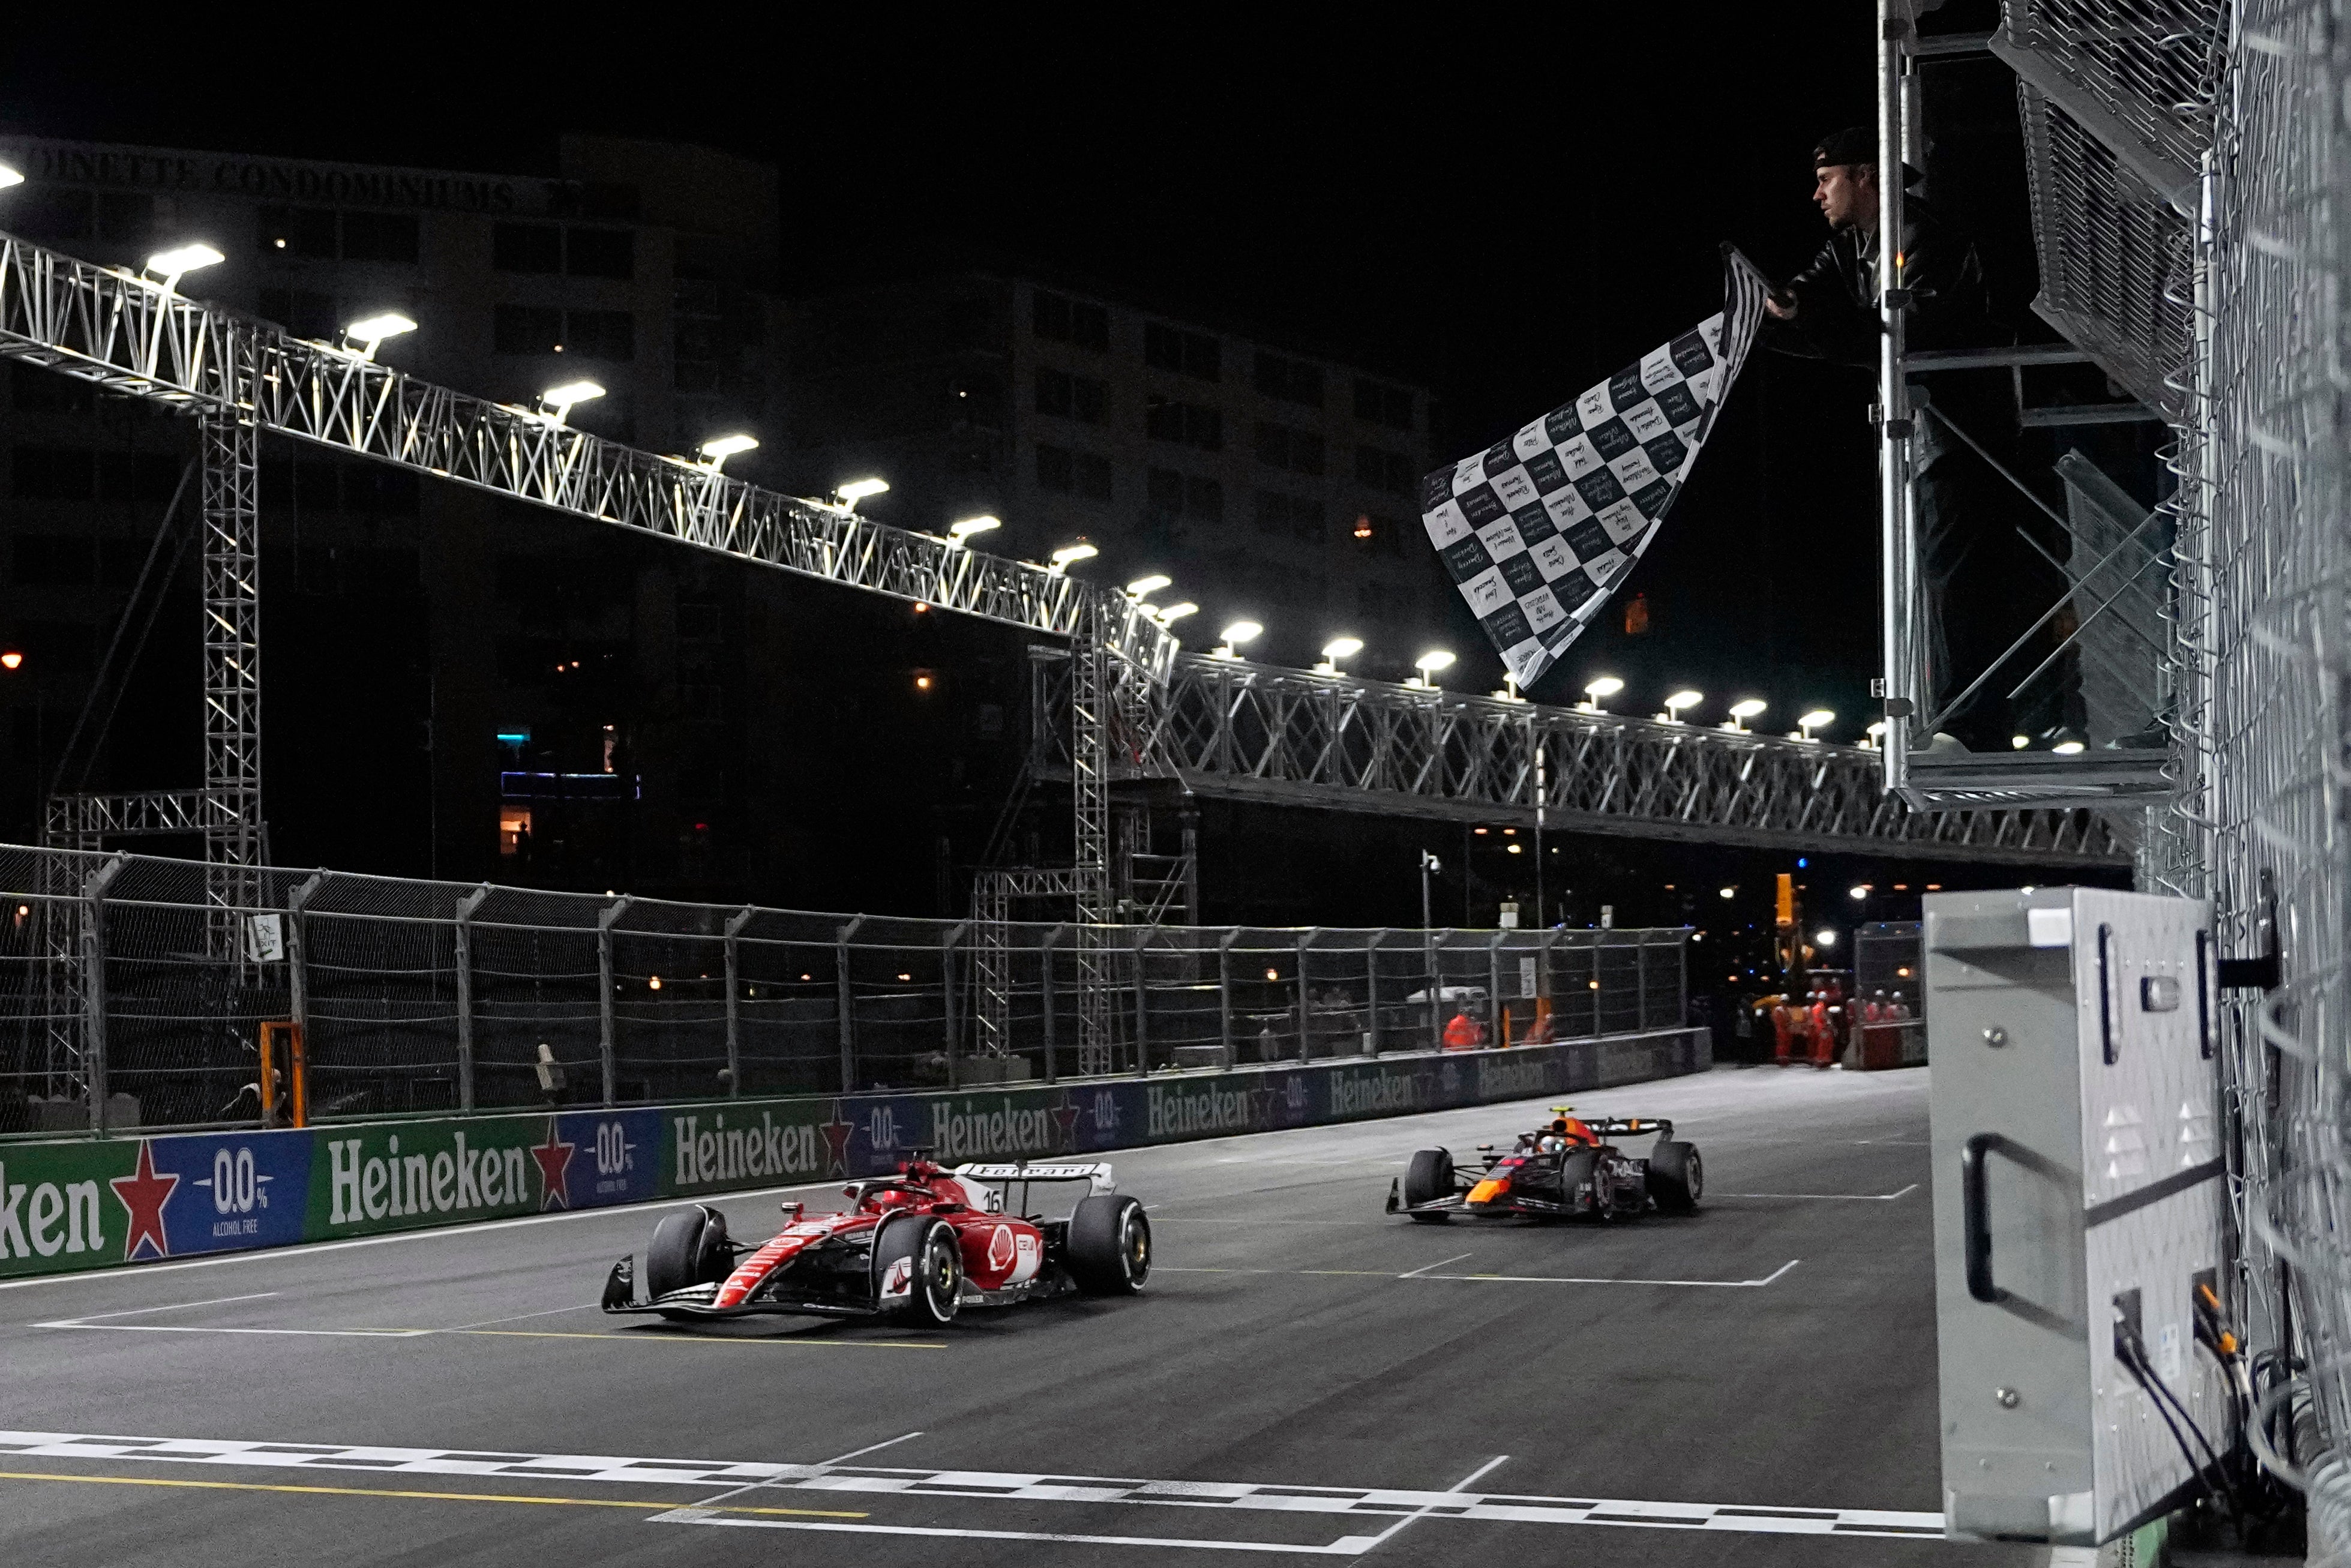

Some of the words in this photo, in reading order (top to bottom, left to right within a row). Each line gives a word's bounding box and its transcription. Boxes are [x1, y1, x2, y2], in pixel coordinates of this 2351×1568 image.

[214, 161, 514, 210] CONDOMINIUMS
[932, 1098, 1048, 1160] Heineken
[1147, 1081, 1248, 1138] Heineken
[673, 1111, 817, 1185] Heineken
[328, 1132, 528, 1225] Heineken
[983, 1190, 1000, 1213] 16
[212, 1220, 241, 1237] ALCOHOL
[243, 1218, 258, 1234] FREE
